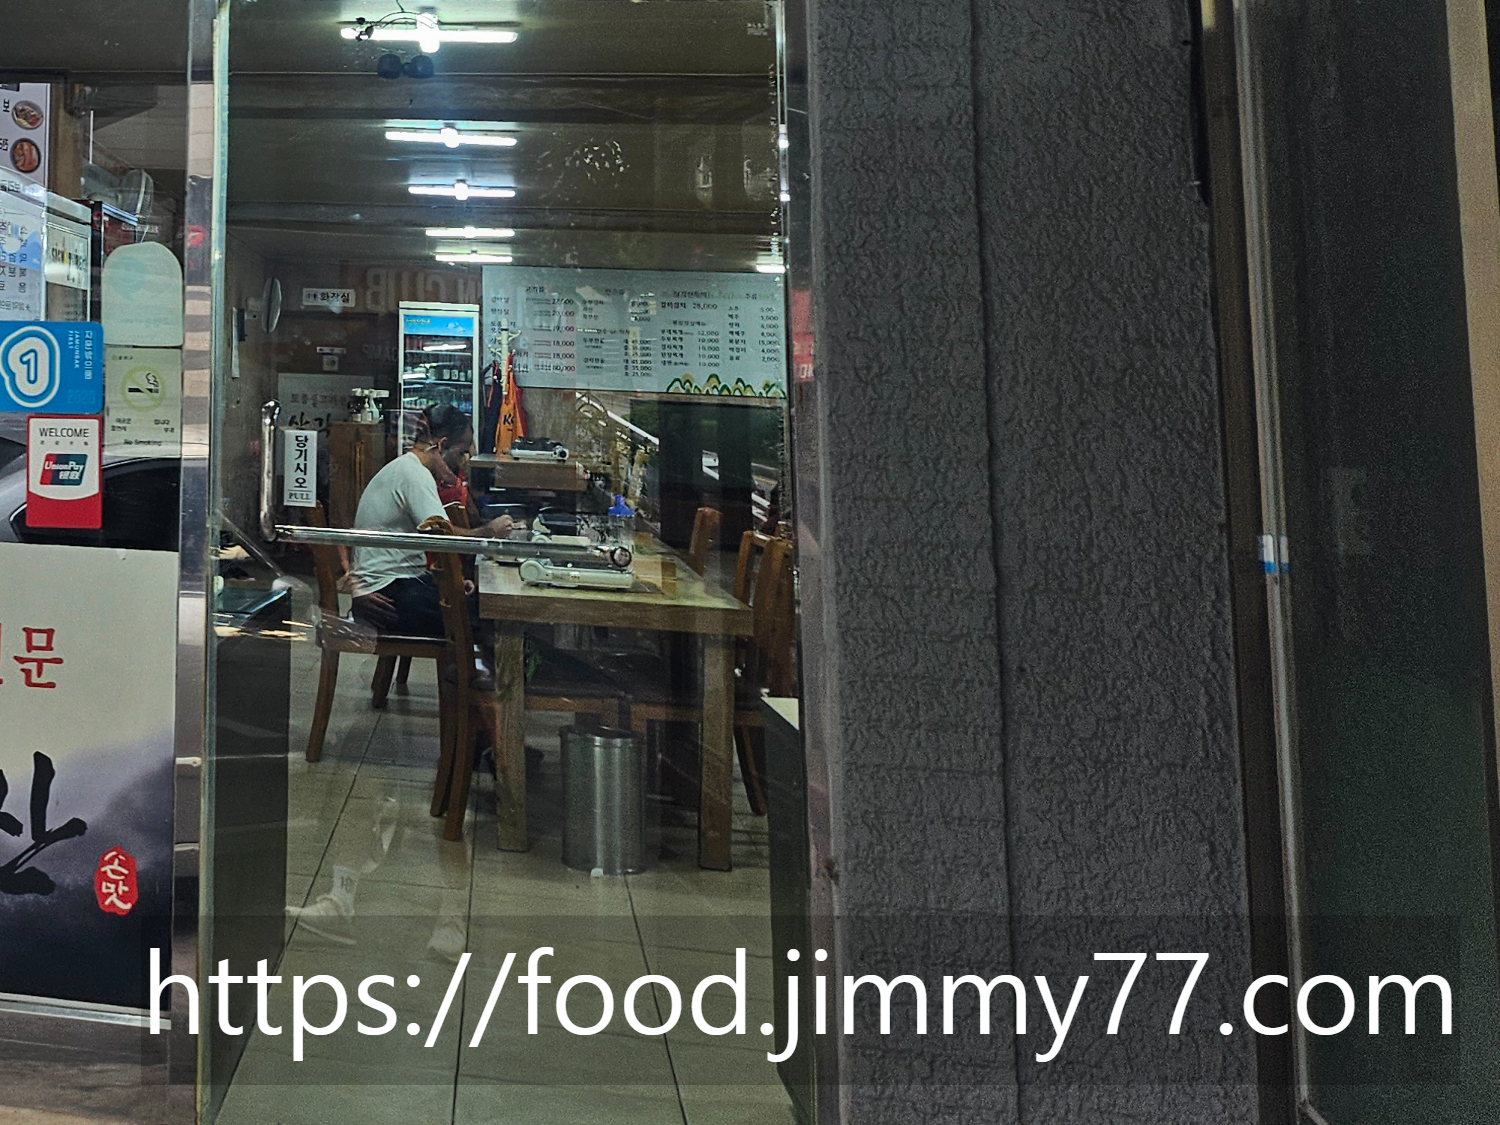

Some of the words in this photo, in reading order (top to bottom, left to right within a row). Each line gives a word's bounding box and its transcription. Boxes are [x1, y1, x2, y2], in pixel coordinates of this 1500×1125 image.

[320, 291, 351, 304] 화장실
[39, 427, 90, 438] WELCOME
[44, 461, 84, 473] UnionPay
[294, 435, 309, 489] 당기시오
[288, 492, 311, 501] PULL
[100, 851, 132, 911] 손맛
